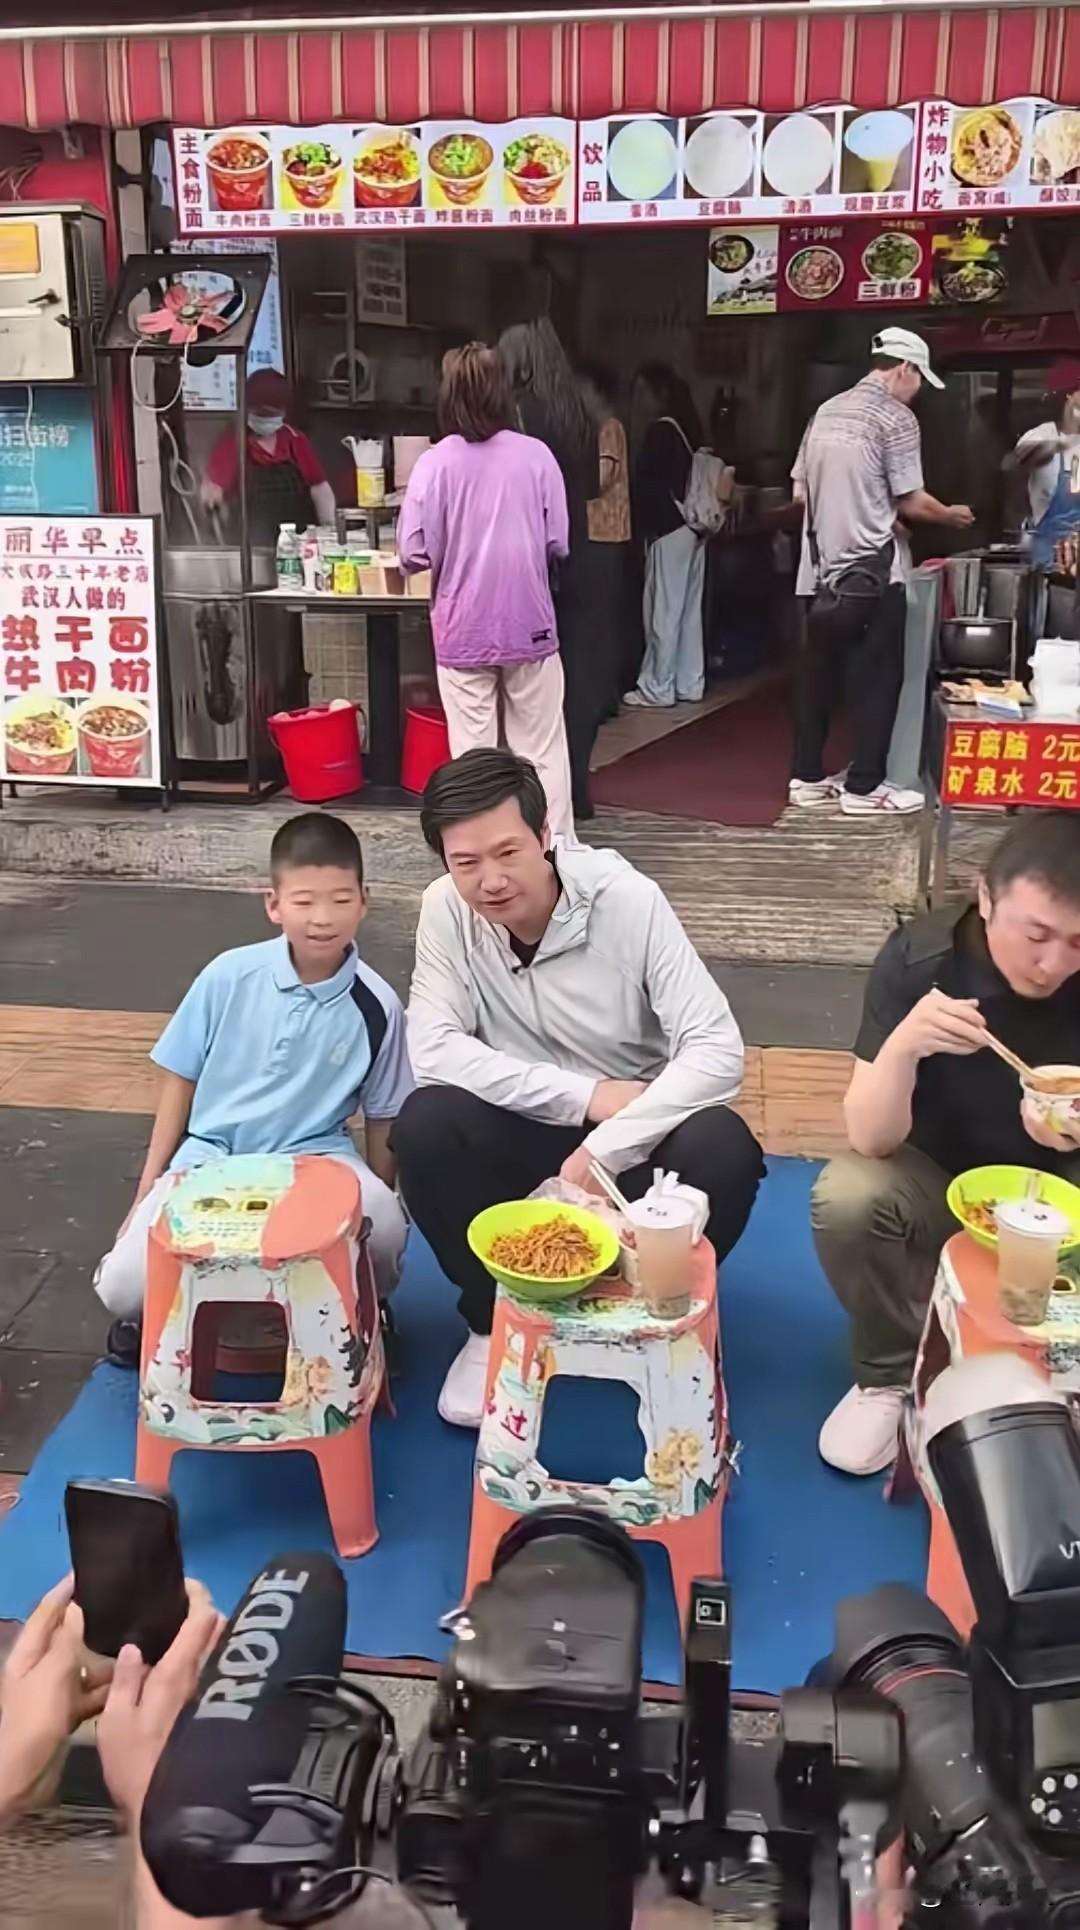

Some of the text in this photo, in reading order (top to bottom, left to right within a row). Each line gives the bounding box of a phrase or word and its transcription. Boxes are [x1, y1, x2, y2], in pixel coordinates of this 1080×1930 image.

[922, 104, 949, 210] 炸物小吃
[180, 132, 202, 228] 主食粉面
[583, 143, 603, 202] 饮品
[215, 211, 271, 227] 牛肉粉面
[290, 211, 345, 227] 三鲜粉面
[354, 209, 425, 225] 武汉热干面
[435, 208, 494, 223] 炸酱粉面
[509, 207, 567, 222] 肉丝粉面
[862, 277, 917, 297] 三鲜粉
[4, 526, 144, 555] 丽华早点
[22, 585, 126, 611] 武汉人做的
[2, 614, 149, 653] 热干面
[5, 655, 150, 693] 牛肉粉
[951, 729, 1080, 762] 豆腐脑 2元
[947, 765, 1078, 799] 矿泉水 2元
